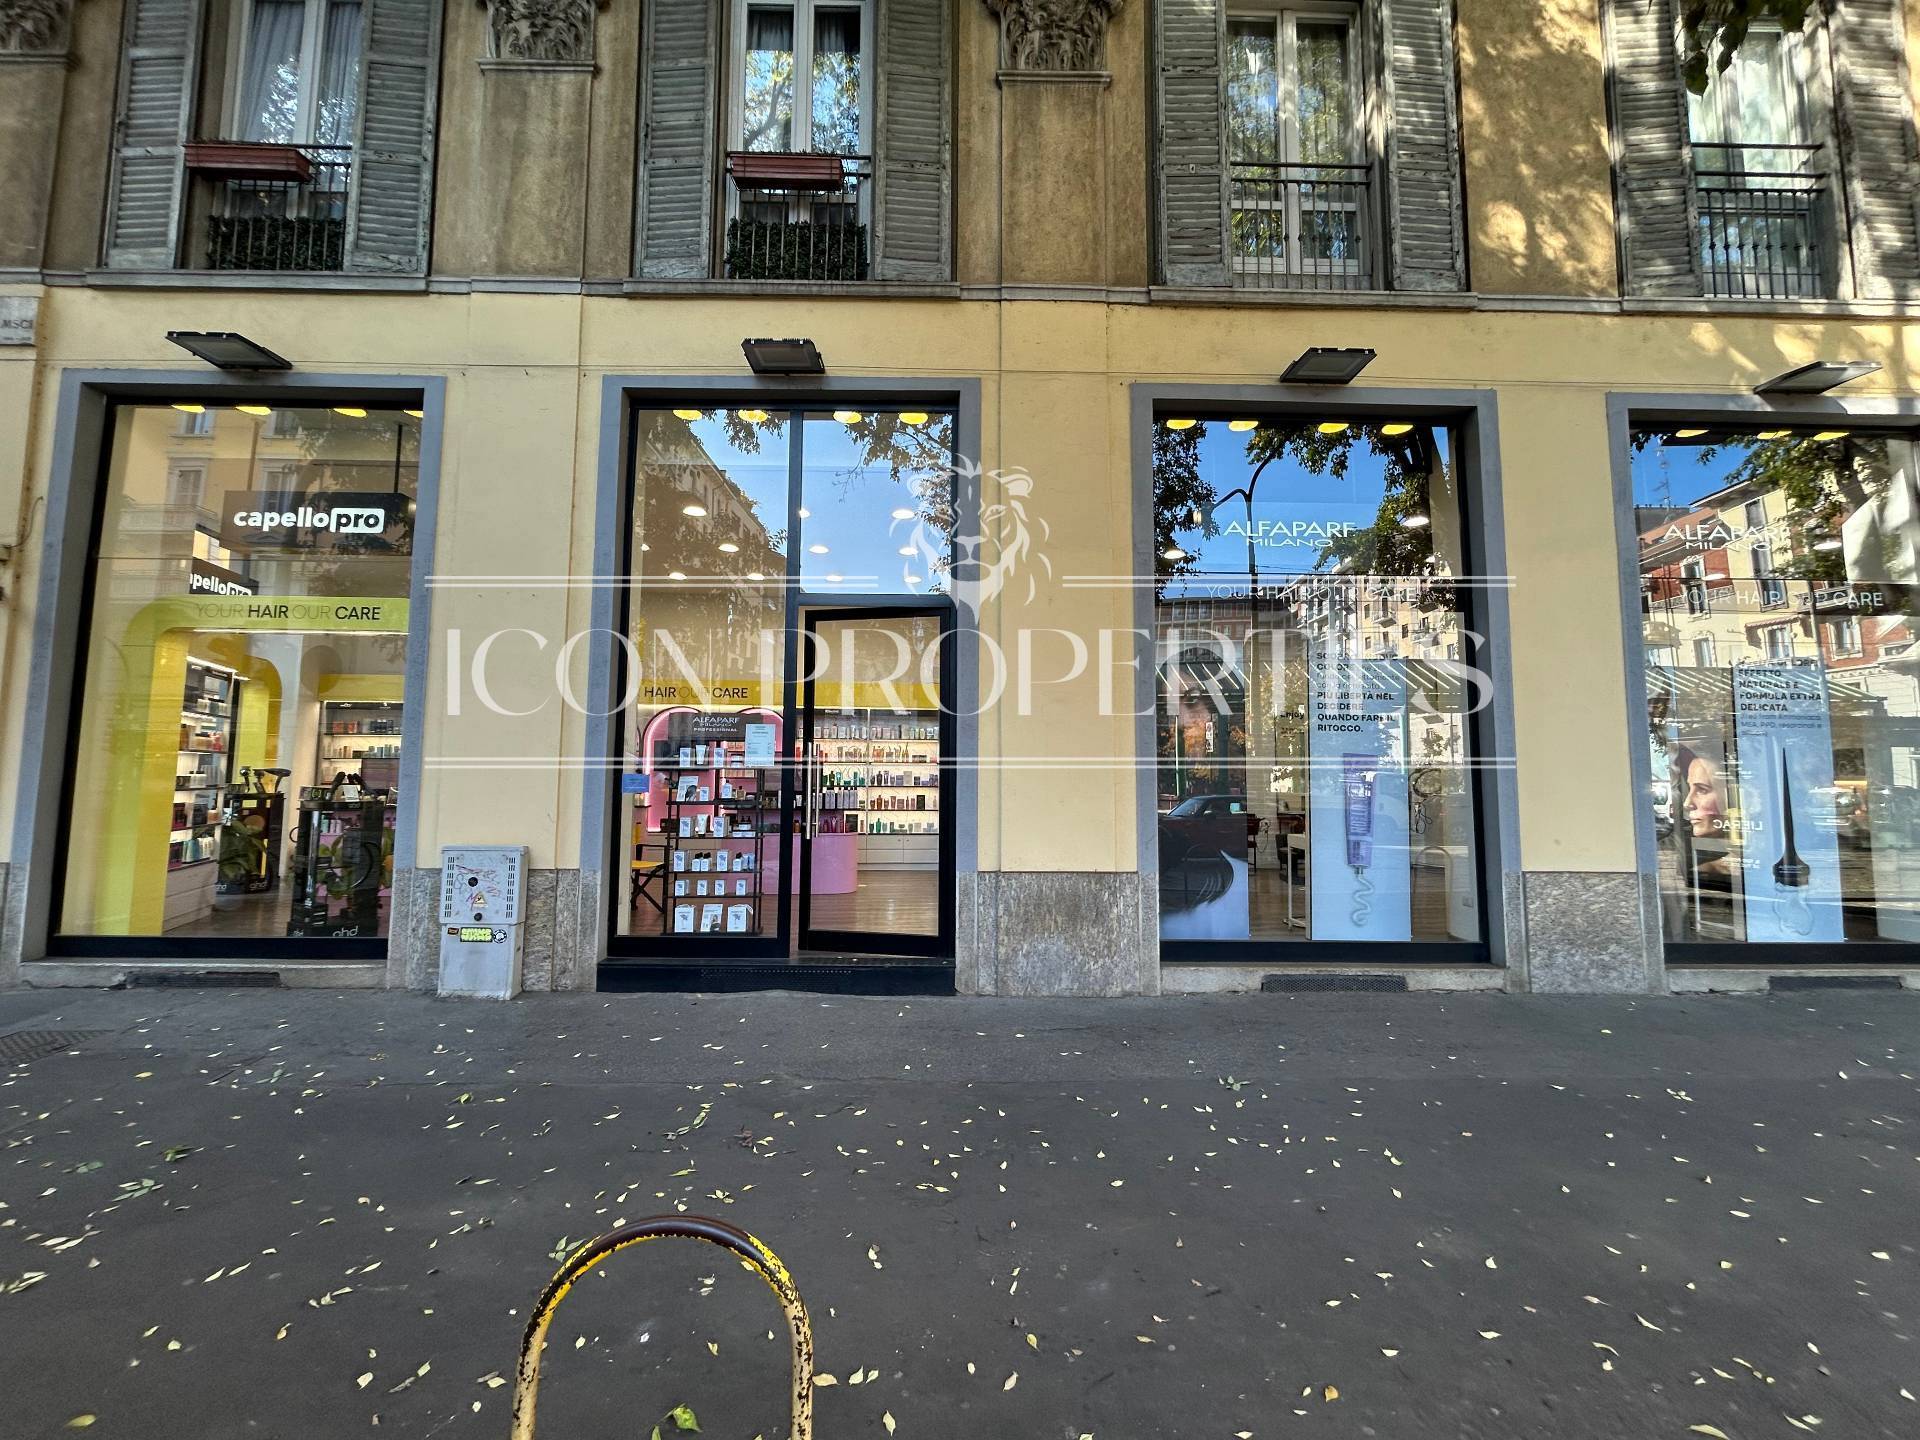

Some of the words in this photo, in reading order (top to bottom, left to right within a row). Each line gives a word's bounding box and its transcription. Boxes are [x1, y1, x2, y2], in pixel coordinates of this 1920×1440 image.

[1223, 520, 1356, 538] ALFAPARF
[1246, 538, 1334, 548] MILANO
[1206, 584, 1261, 599] YOUR
[1833, 592, 1884, 606] CARE
[198, 603, 244, 618] YOUR
[248, 605, 289, 619] HAIR
[292, 605, 331, 619] OUR
[335, 606, 382, 620] CARE
[644, 686, 677, 698] HAIR
[712, 687, 749, 699] CARE
[1375, 692, 1395, 701] NEL
[1317, 713, 1360, 722] QUANDO
[1317, 724, 1364, 733] RITOCCO.
